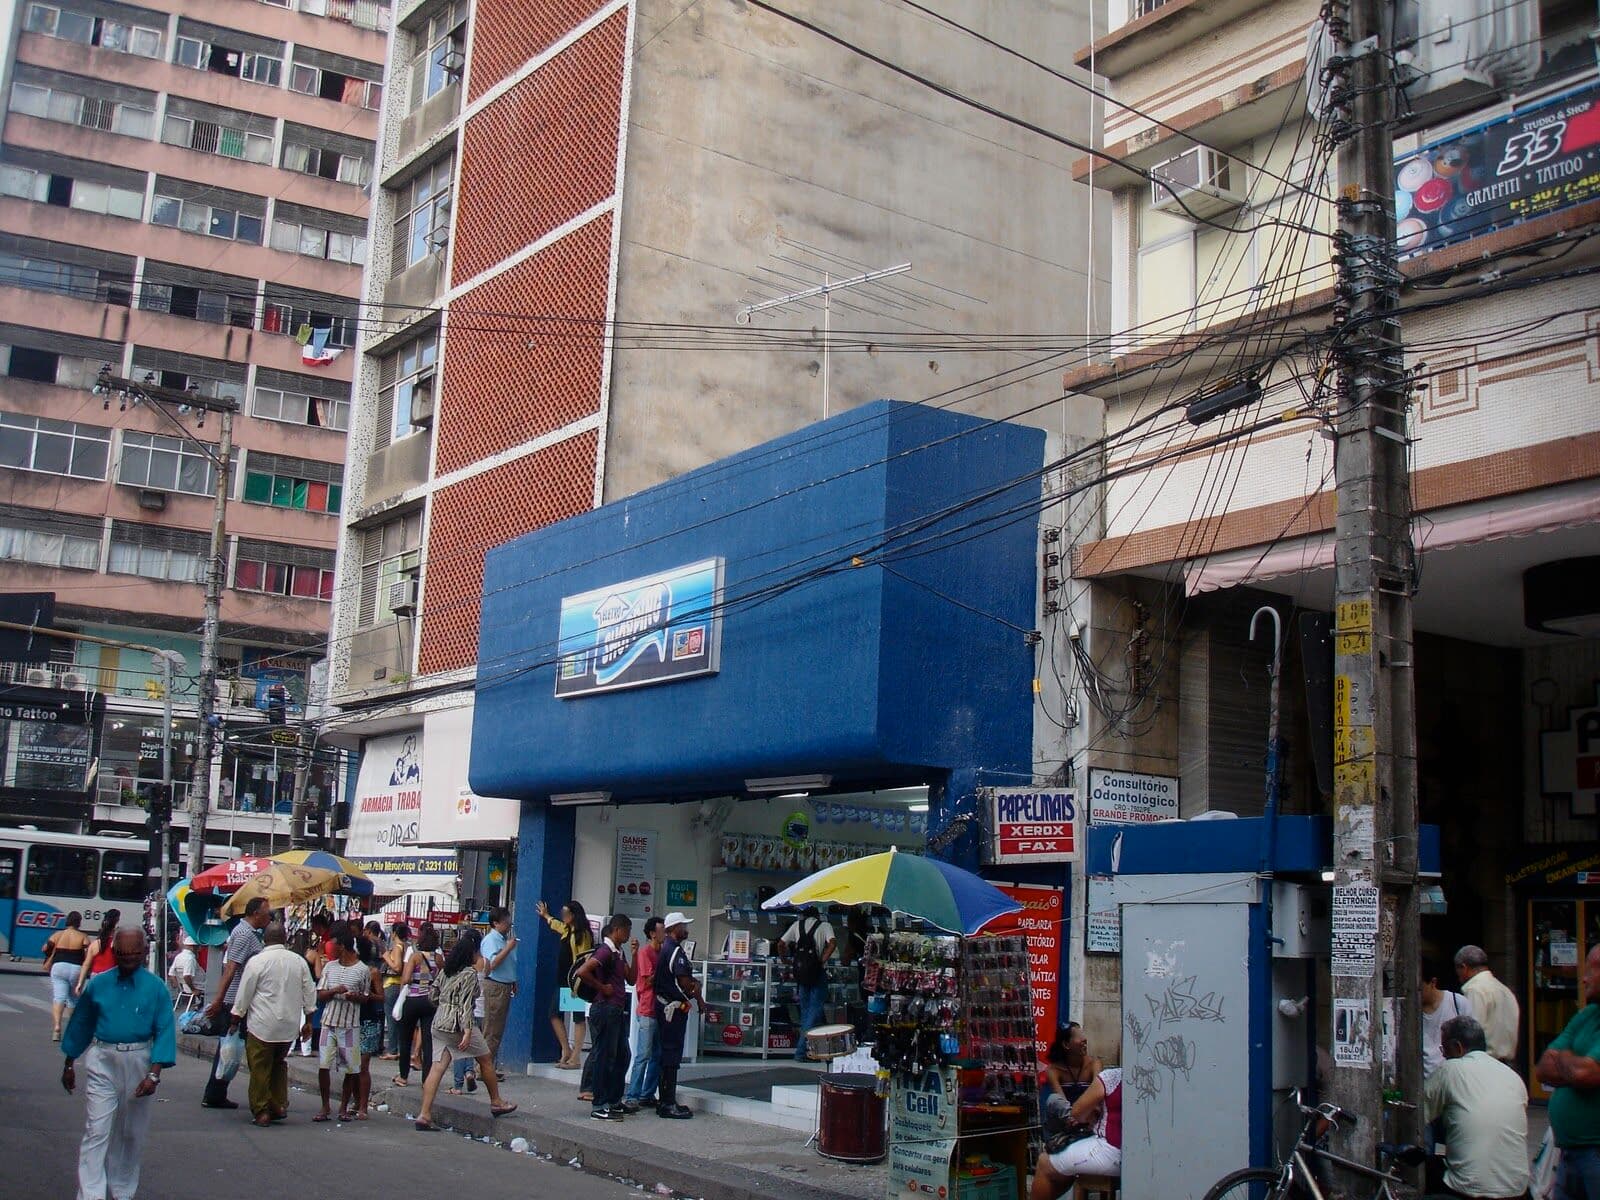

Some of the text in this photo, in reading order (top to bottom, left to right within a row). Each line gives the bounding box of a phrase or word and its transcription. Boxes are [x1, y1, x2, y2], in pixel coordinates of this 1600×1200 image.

[1523, 114, 1556, 132] STUDIO
[1566, 102, 1591, 117] SHOP
[1466, 156, 1583, 207] GRAFFITI TATTOO
[17, 707, 57, 720] Tattoo
[1103, 775, 1168, 793] Consultório
[997, 793, 1075, 822] PAPELMAIS
[1093, 809, 1127, 820] GRANDE
[1011, 825, 1064, 836] XEROX
[622, 835, 648, 846] GANHE
[1019, 842, 1057, 851] FAX
[425, 860, 441, 871] 3231
[670, 883, 689, 891] AQUI
[1335, 886, 1378, 897] MELHOR CURSO
[1334, 896, 1377, 905] ELETRÔNICA
[17, 909, 108, 926] CRT 86
[1017, 917, 1053, 930] PAPELARIA
[906, 1091, 938, 1116] Cell
[932, 1154, 949, 1165] geral
[892, 1161, 904, 1171] para
